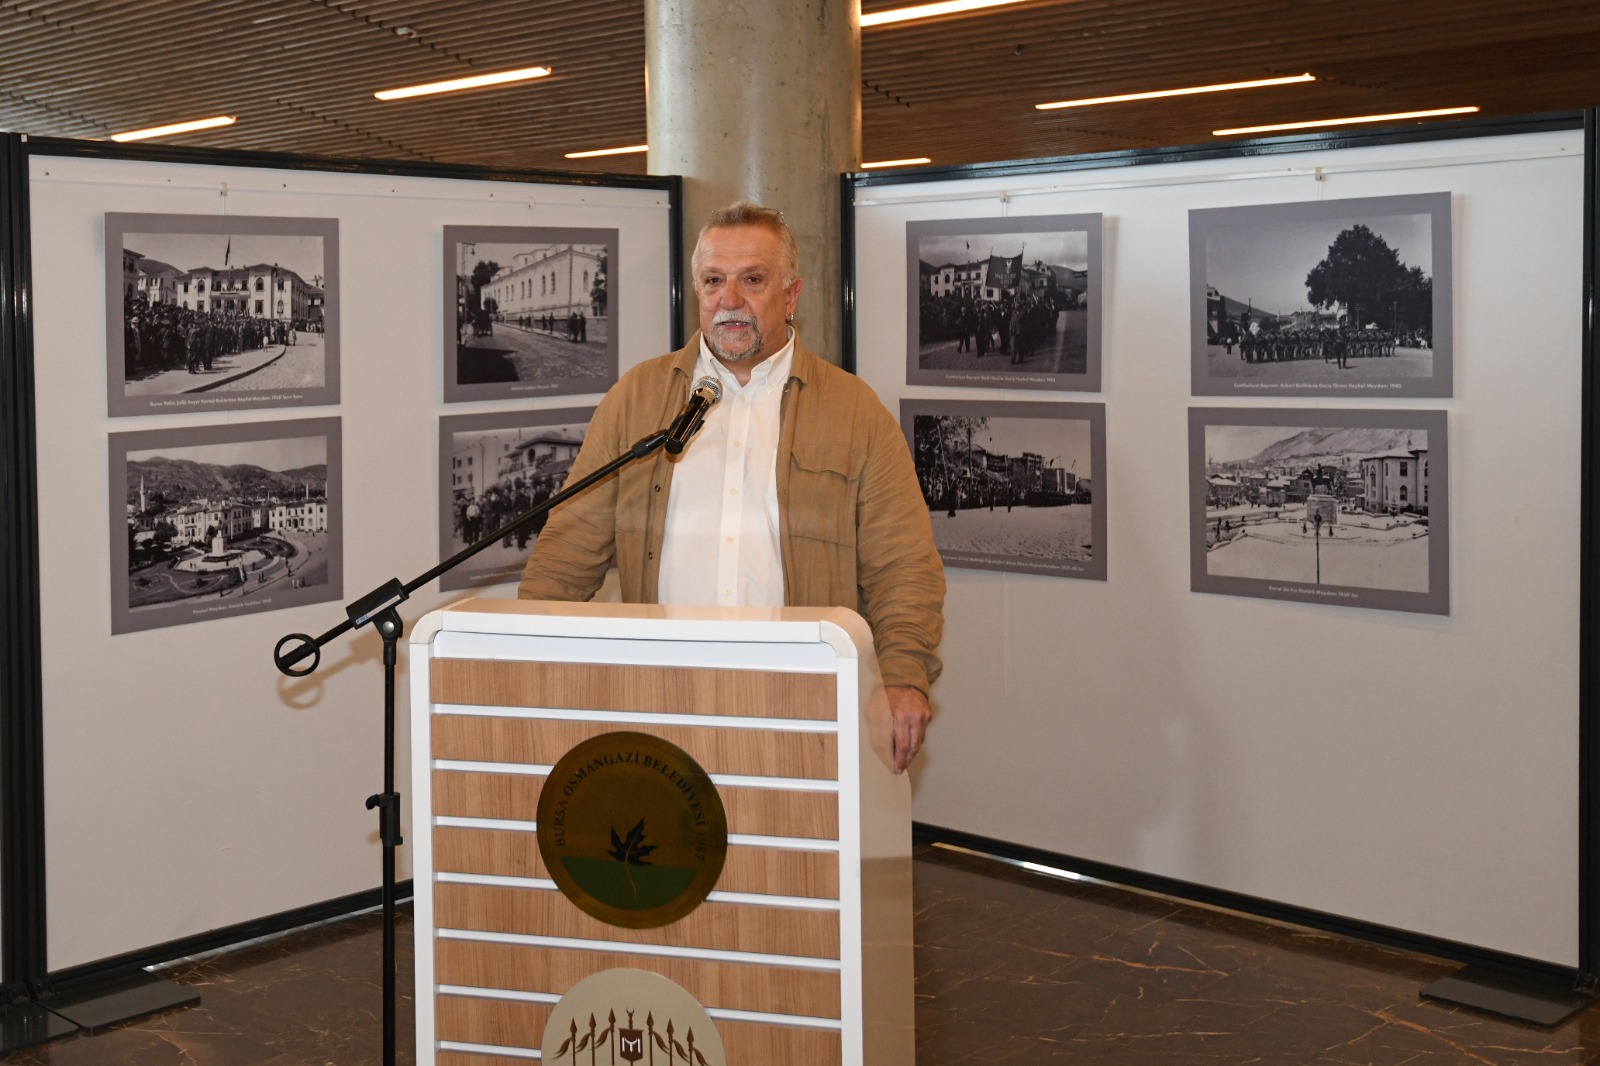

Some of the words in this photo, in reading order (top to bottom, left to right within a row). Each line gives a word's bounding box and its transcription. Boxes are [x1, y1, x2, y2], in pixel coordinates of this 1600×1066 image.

[553, 800, 569, 848] BURSA
[563, 750, 640, 797] OSMANGAZİ
[643, 754, 710, 827] BELEDİYESİ
